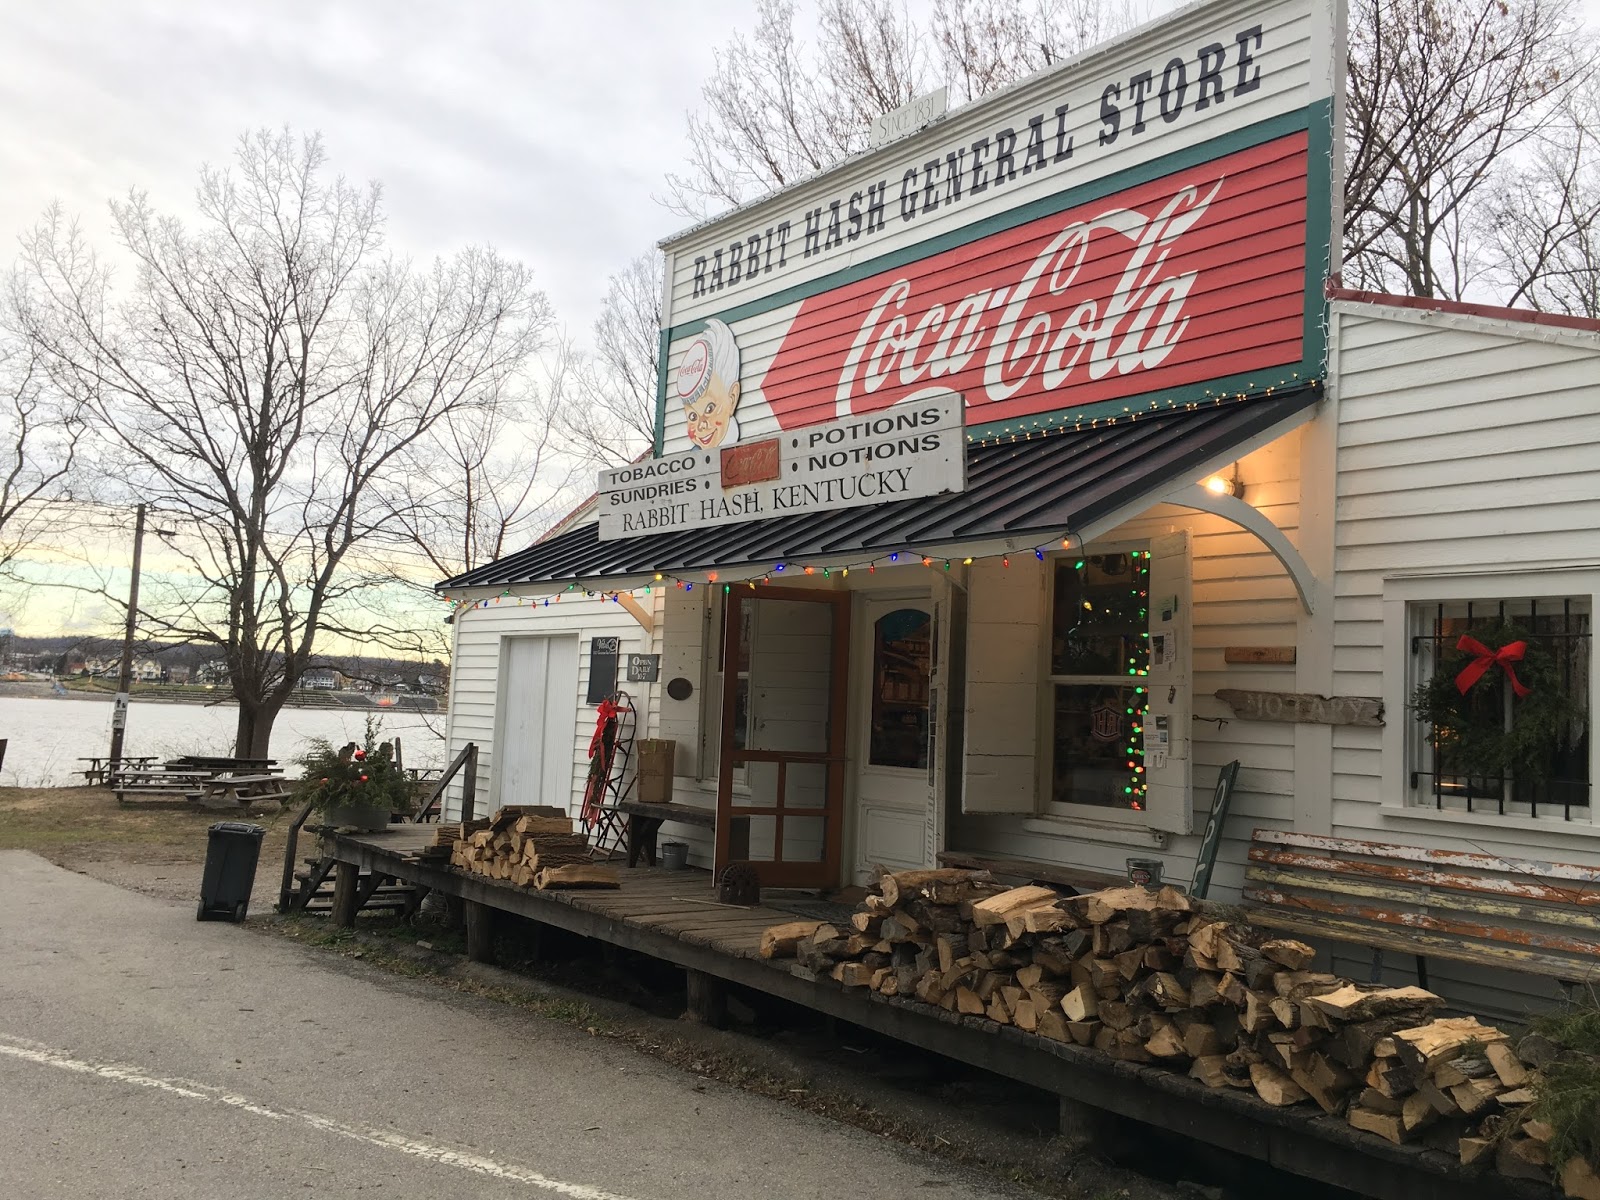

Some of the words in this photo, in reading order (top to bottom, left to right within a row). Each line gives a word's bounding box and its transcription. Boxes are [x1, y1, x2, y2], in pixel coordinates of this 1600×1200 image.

[879, 109, 910, 139] SINCE
[914, 97, 934, 125] 1831
[692, 220, 791, 299] RABBIT
[803, 179, 887, 259] HASH
[899, 103, 1074, 223] GENERAL
[1099, 23, 1263, 147] STORE
[808, 407, 941, 449] POTIONS
[608, 456, 696, 486] TOBACCO
[808, 434, 941, 472] NOTIONS
[610, 478, 697, 507] SUNDRIES
[622, 503, 690, 533] RABBIT
[699, 491, 764, 521] HASH,
[772, 466, 913, 510] KENTUCKY
